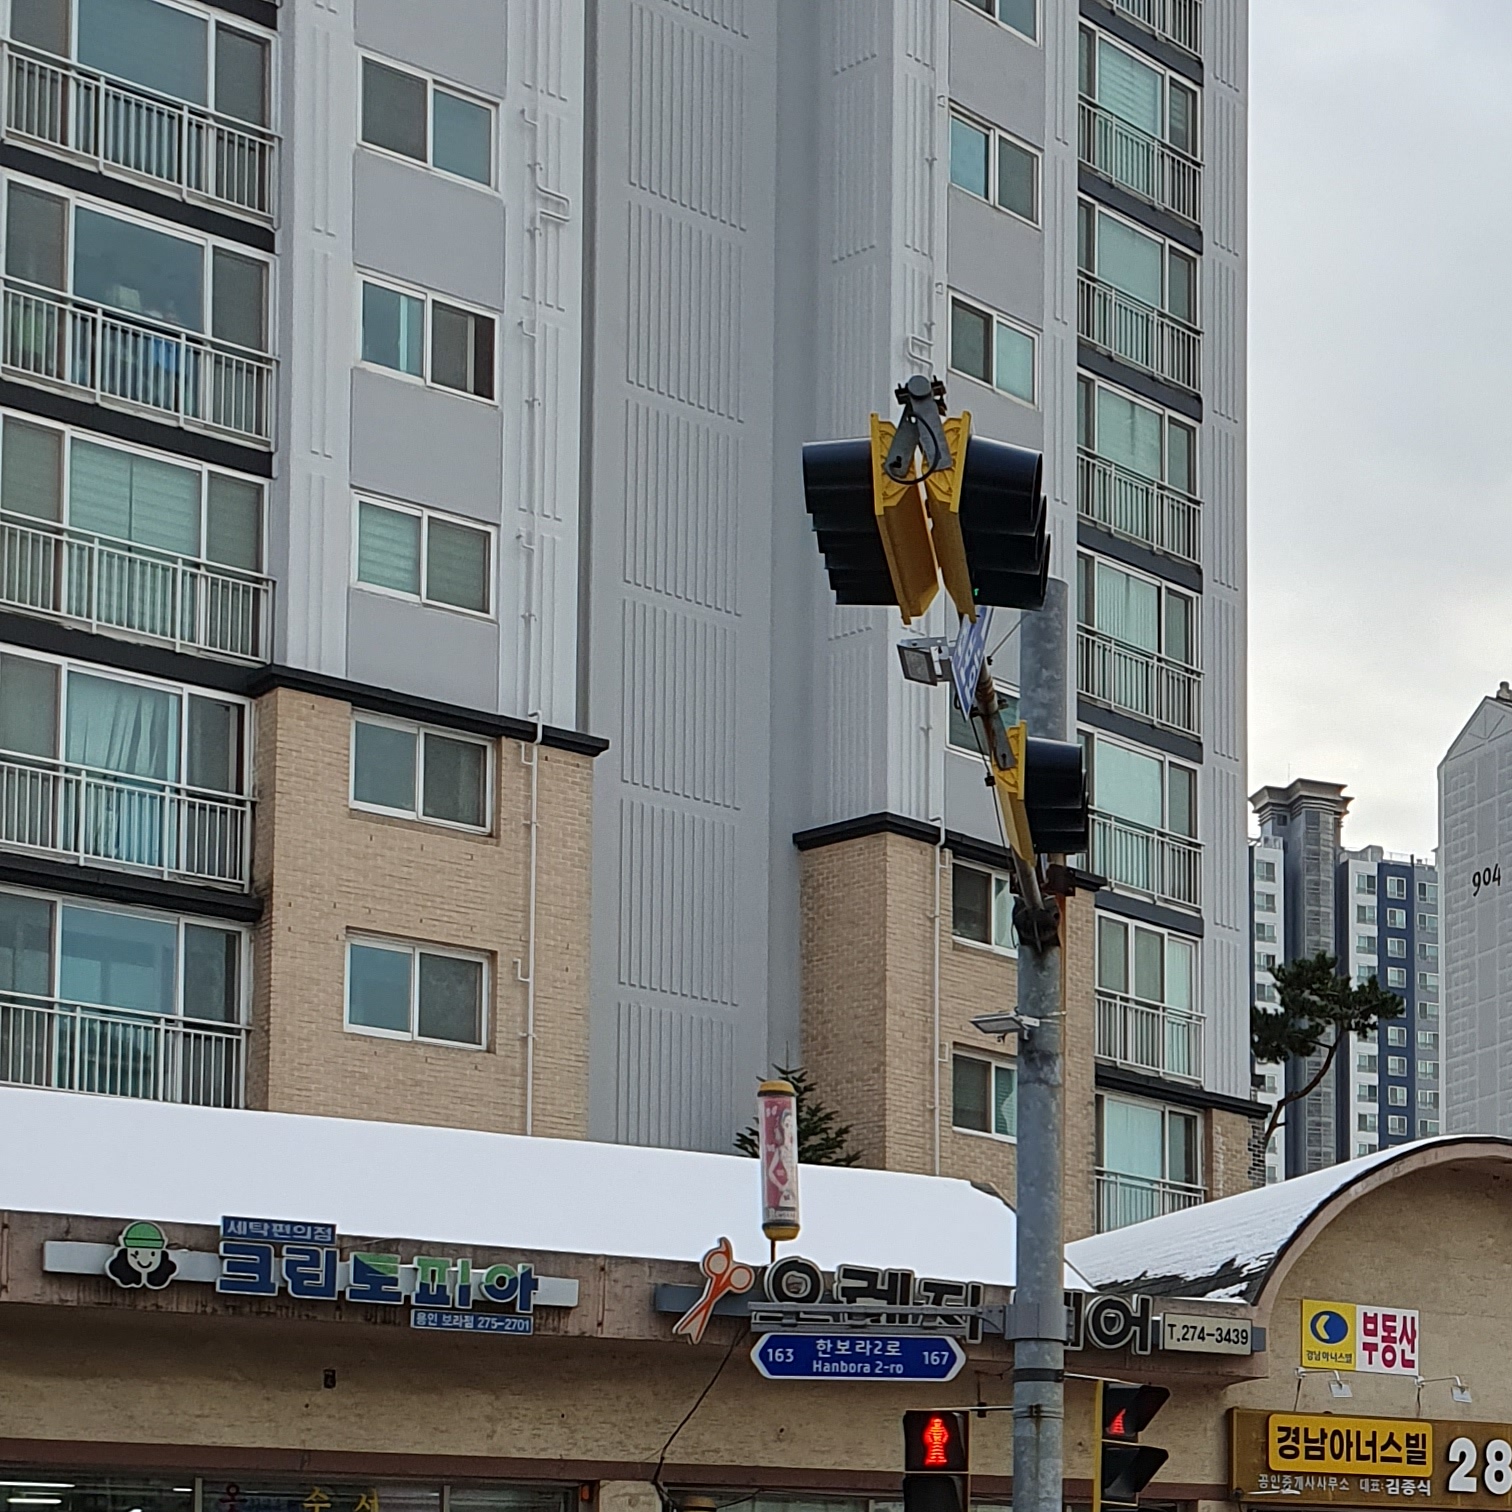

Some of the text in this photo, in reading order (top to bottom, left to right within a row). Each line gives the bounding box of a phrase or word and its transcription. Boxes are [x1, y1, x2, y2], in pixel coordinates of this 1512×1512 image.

[1472, 863, 1501, 897] 904
[226, 1220, 333, 1242] 세탁편의점
[216, 1241, 539, 1314] 크린토피아
[477, 1317, 530, 1331] 275-2701
[1167, 1323, 1249, 1346] T.274-3439
[815, 1339, 903, 1358] 한보라2로
[1362, 1311, 1417, 1369] 부동산
[767, 1348, 794, 1362] 163
[922, 1351, 950, 1366] 167
[812, 1360, 904, 1374] Hanbora 2-ro
[1277, 1426, 1427, 1466] 경남아너스빌
